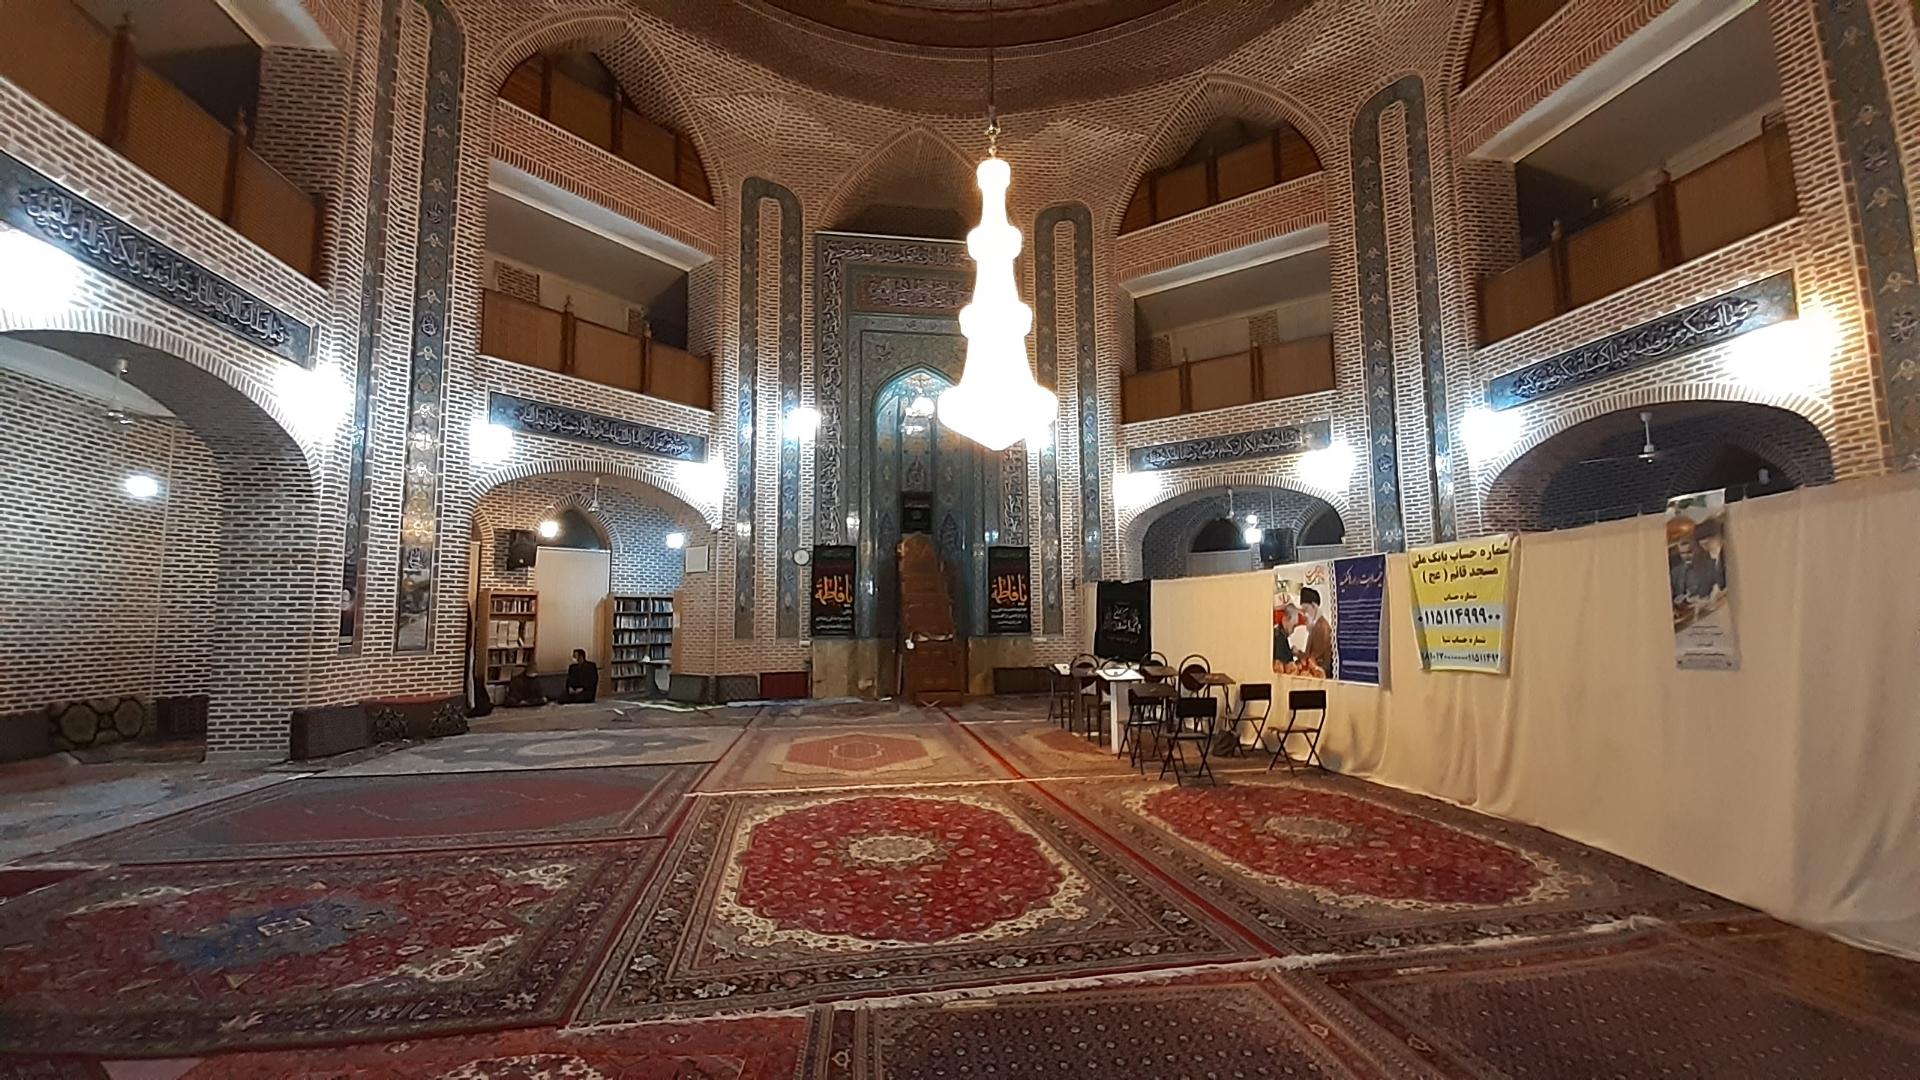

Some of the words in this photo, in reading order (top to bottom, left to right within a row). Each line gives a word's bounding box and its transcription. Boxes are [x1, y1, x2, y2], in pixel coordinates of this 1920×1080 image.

[1412, 554, 1426, 568] ملی
[1428, 551, 1447, 564] بانک
[1450, 548, 1476, 562] حساب
[1450, 565, 1467, 582] قائم
[1469, 567, 1498, 579] مسجد
[1460, 592, 1477, 601] شماره
[1469, 635, 1486, 646] شماره
